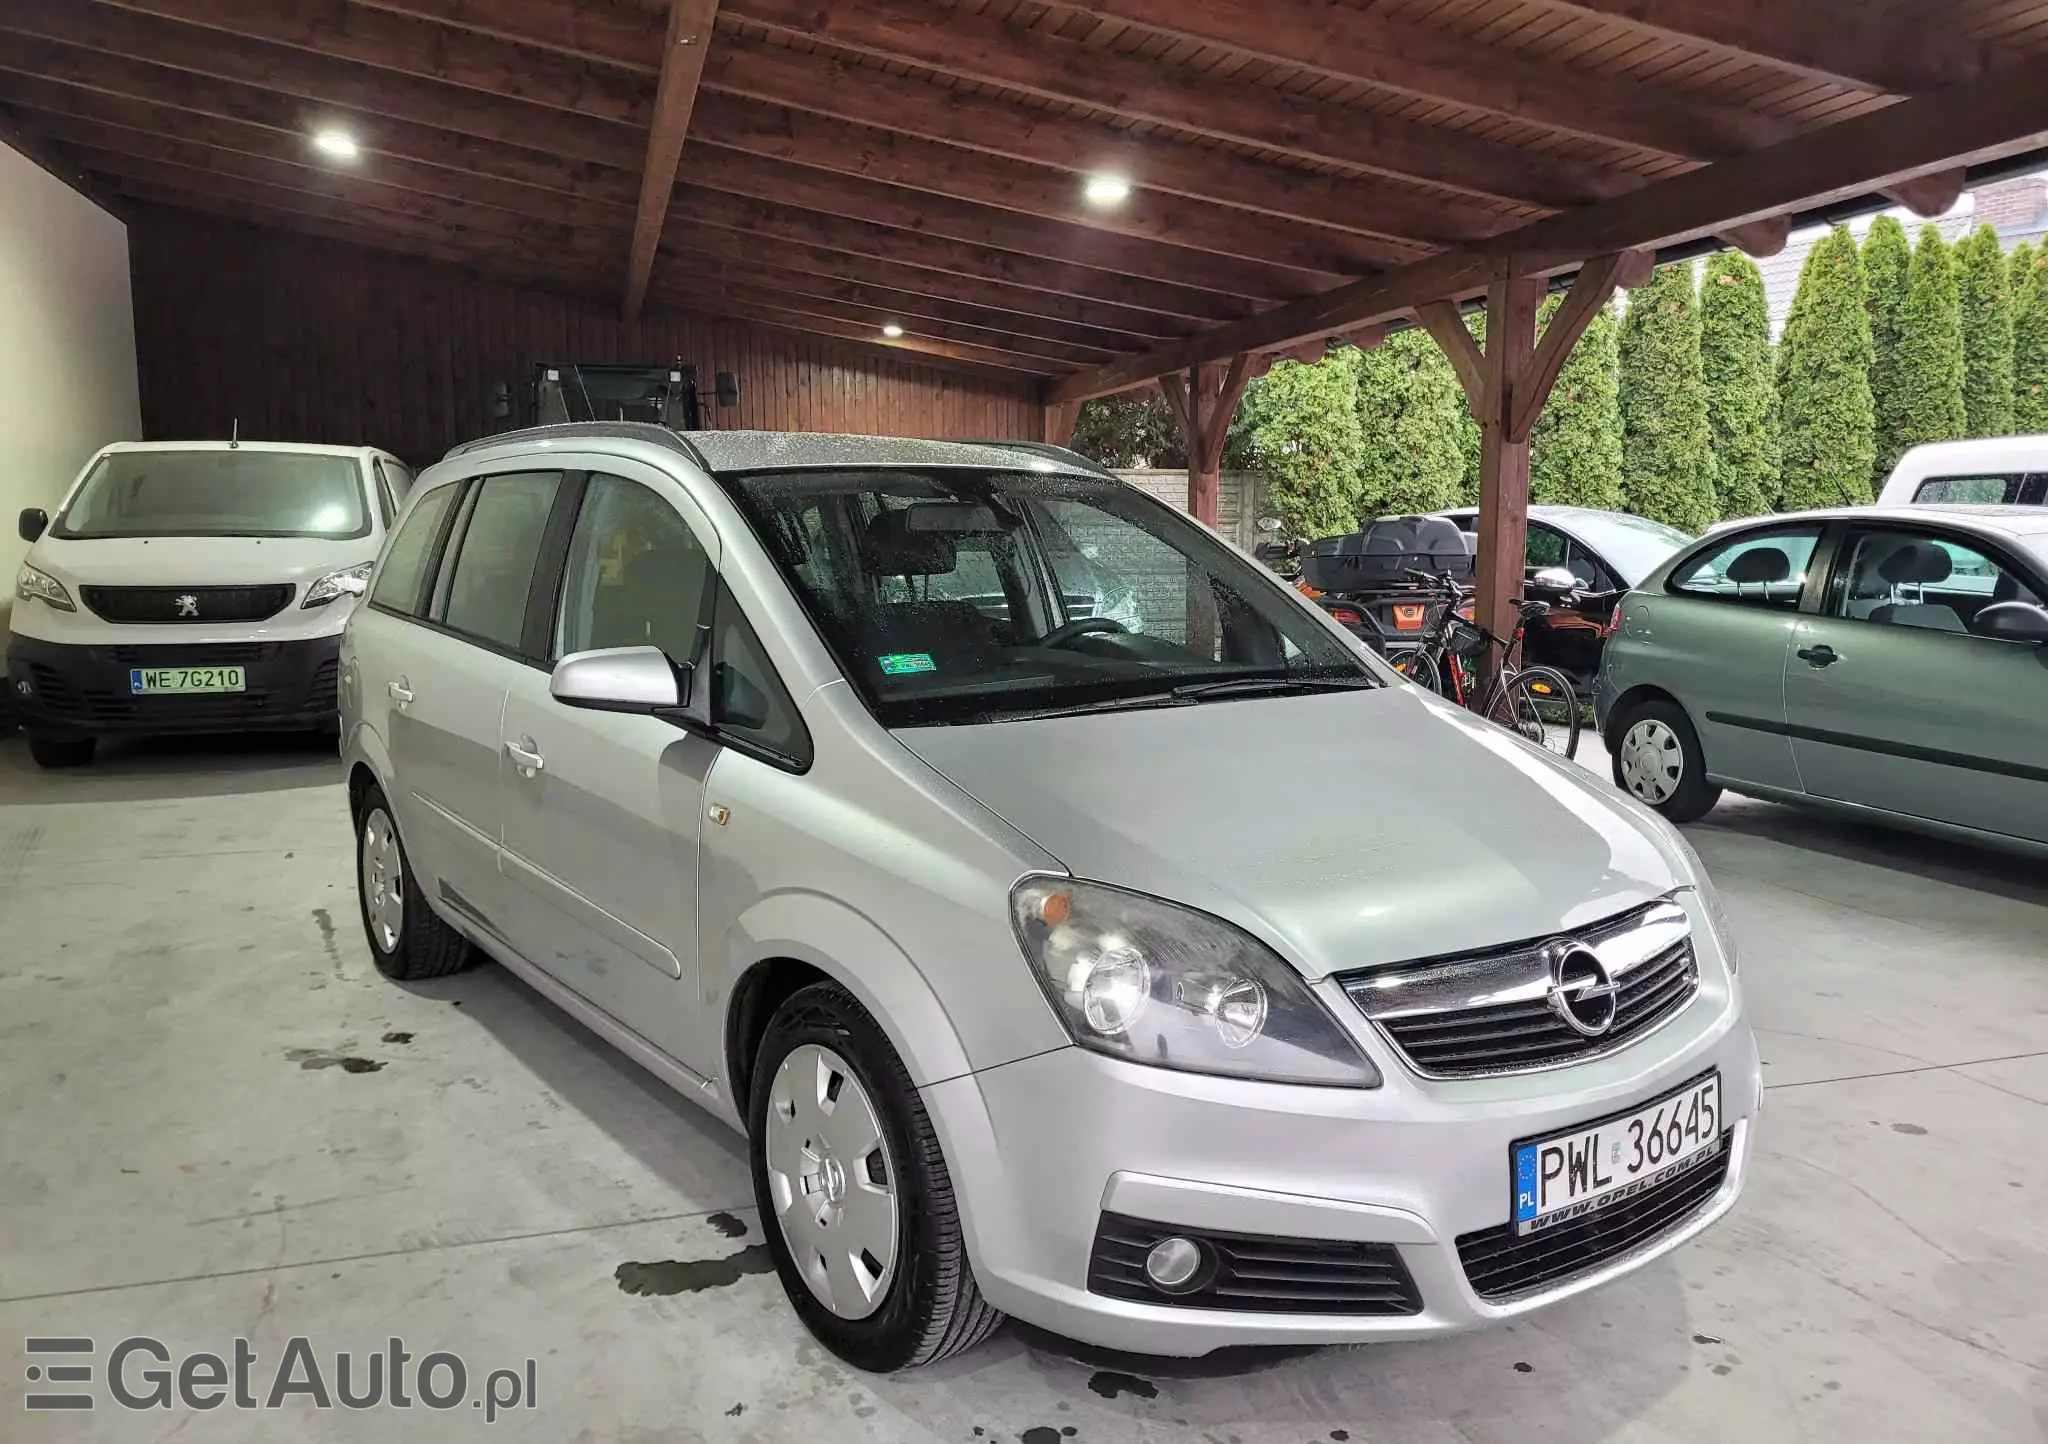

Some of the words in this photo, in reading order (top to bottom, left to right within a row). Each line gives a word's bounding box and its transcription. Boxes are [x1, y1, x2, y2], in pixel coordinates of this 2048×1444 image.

[145, 671, 171, 688] WE
[178, 669, 239, 688] 7G210
[1541, 1133, 1613, 1208] PWL
[1627, 1084, 1715, 1174] 36645
[1519, 1191, 1535, 1209] PL
[1530, 1148, 1713, 1231] WWW.OPEL.COM.PL
